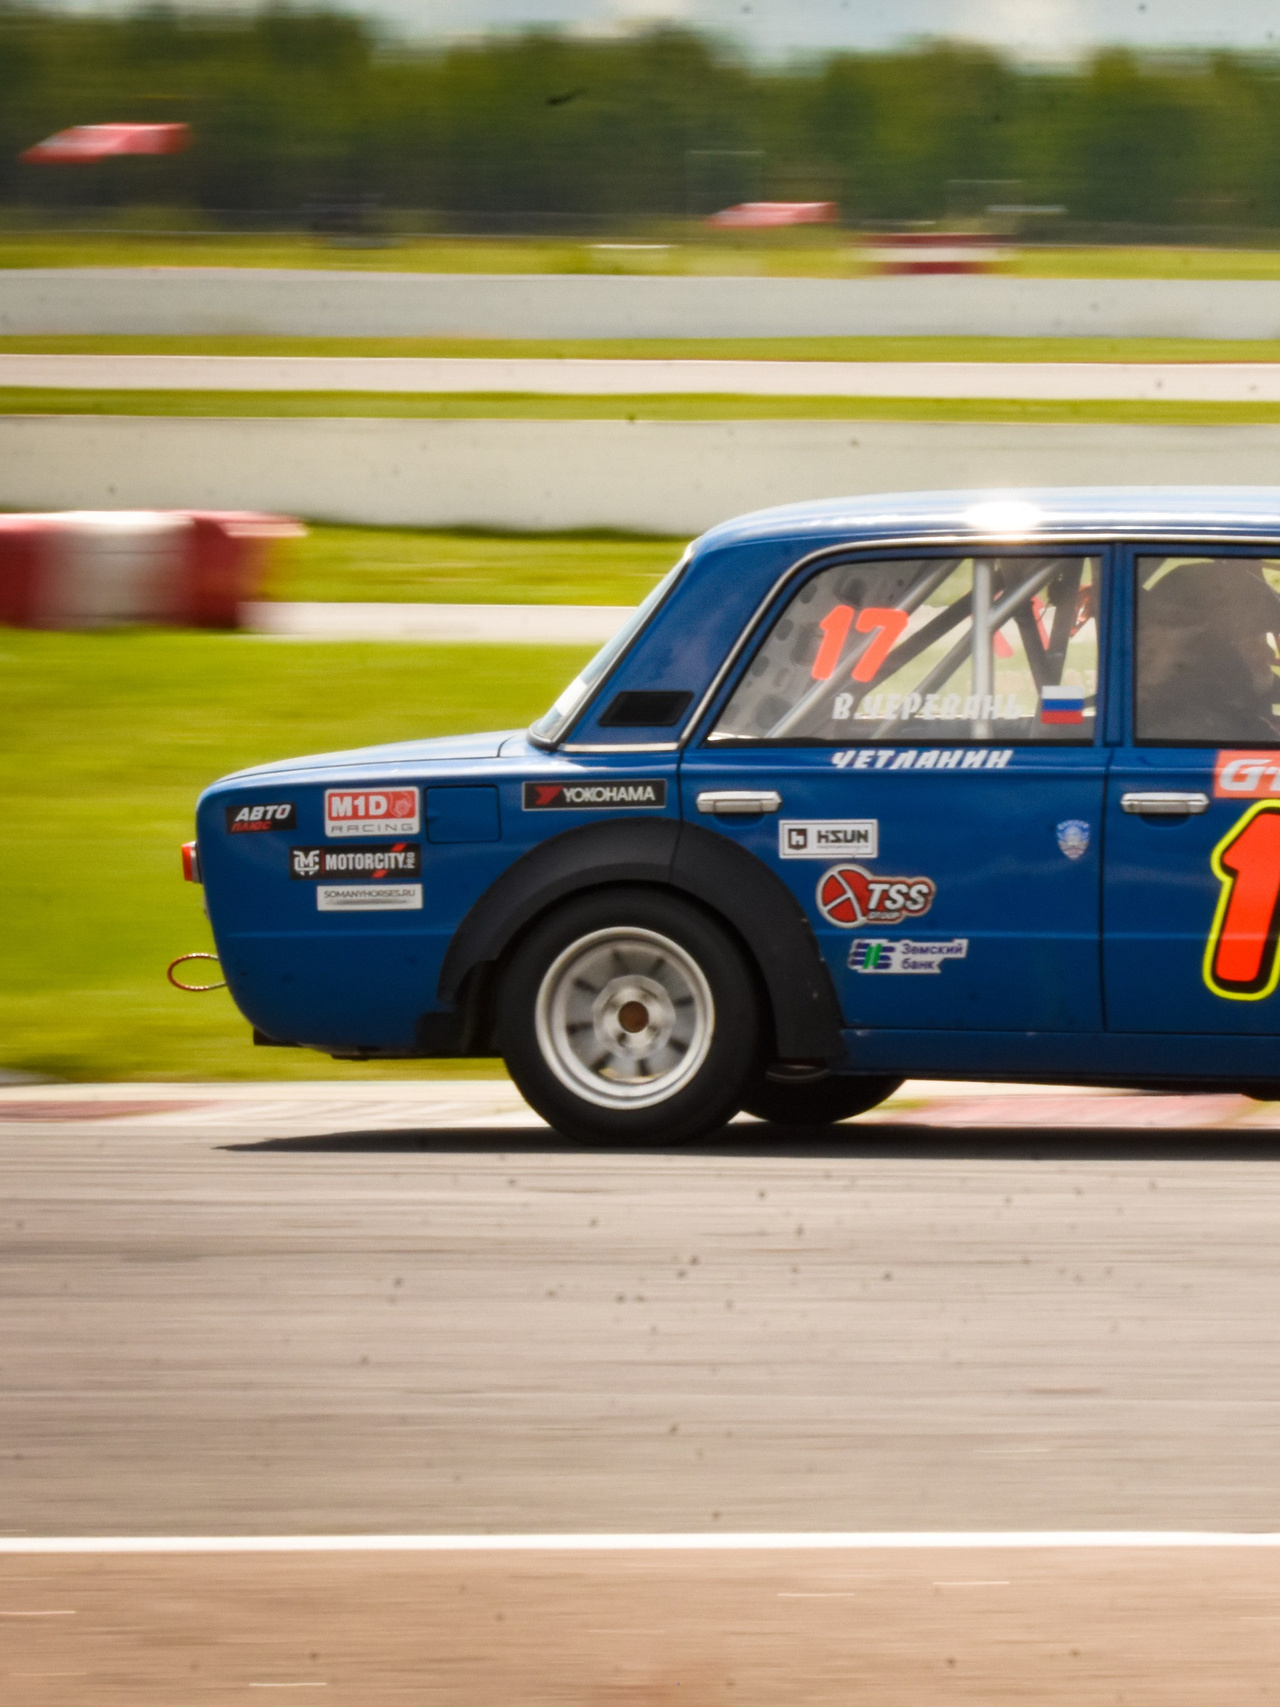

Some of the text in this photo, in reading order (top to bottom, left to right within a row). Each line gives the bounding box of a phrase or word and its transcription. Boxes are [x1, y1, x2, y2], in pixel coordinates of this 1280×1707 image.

[811, 604, 909, 683] 17
[831, 750, 1014, 770] ЧЕТЛАНИН
[562, 786, 656, 803] YOKOHAMA
[234, 804, 292, 822] АВТО
[331, 795, 388, 817] M1D
[331, 823, 413, 833] RACING
[817, 829, 868, 843] HSUN
[867, 883, 929, 911] TSS
[901, 943, 963, 954] Земский
[901, 958, 935, 970] банк
